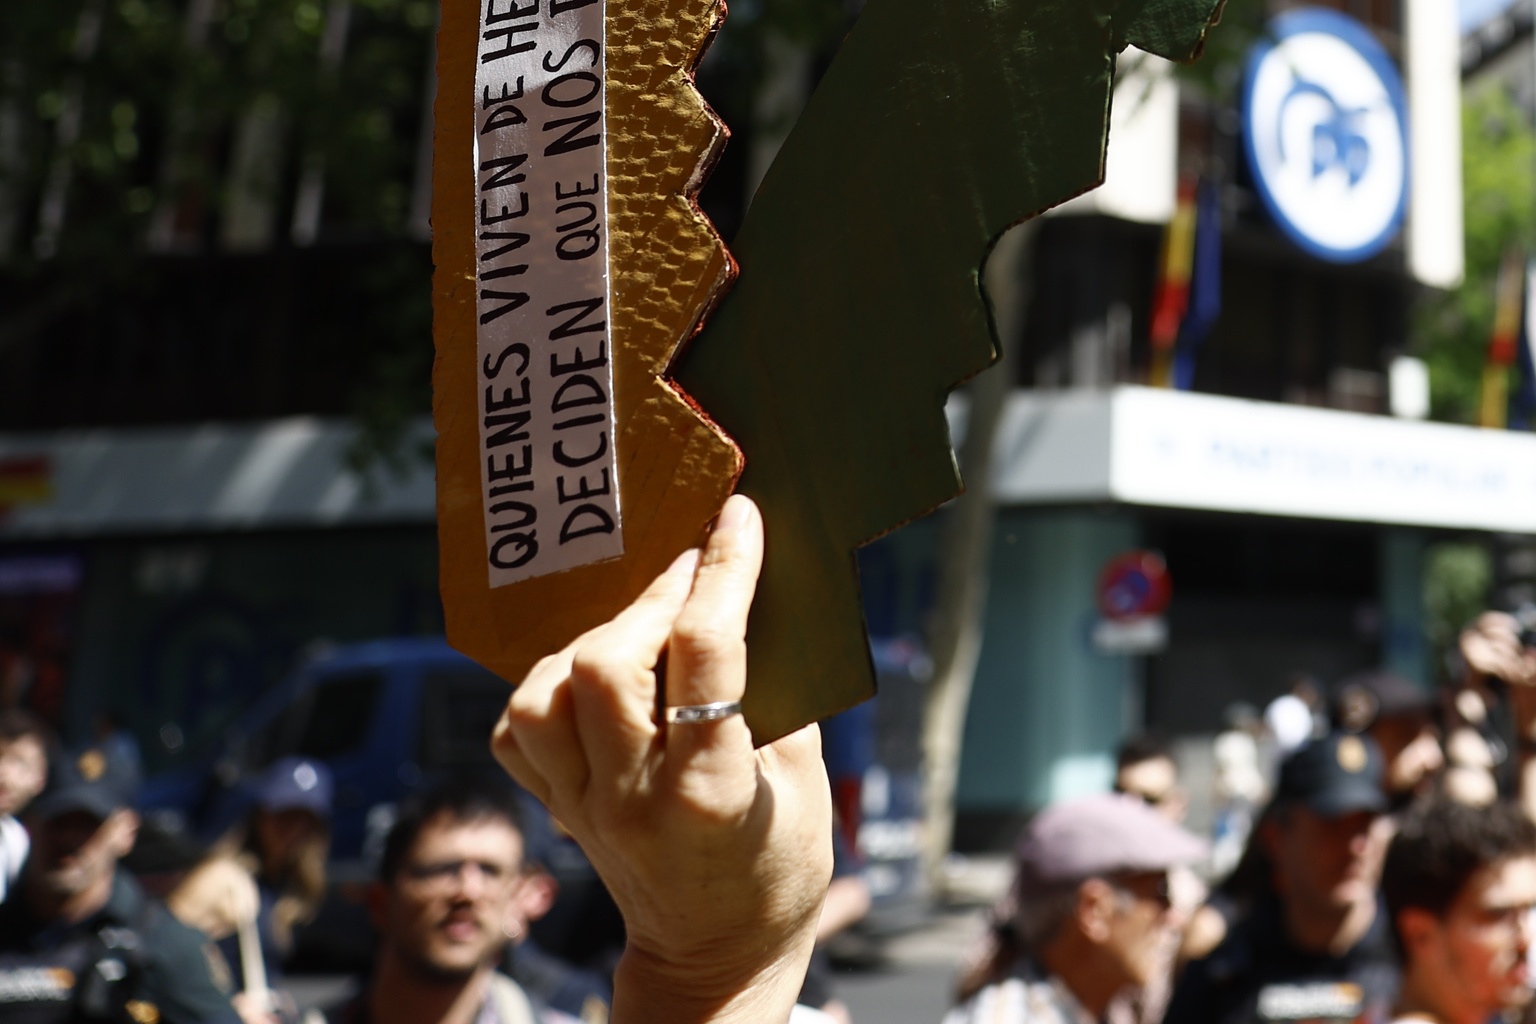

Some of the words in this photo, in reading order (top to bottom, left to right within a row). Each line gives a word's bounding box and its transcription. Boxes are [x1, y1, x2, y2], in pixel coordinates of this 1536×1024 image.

[480, 75, 528, 135] DE
[541, 38, 601, 157] NOS
[479, 153, 531, 325] VIVEN
[555, 172, 600, 261] QUE
[483, 342, 539, 569] QUIENES
[545, 296, 615, 545] DECIDEN
